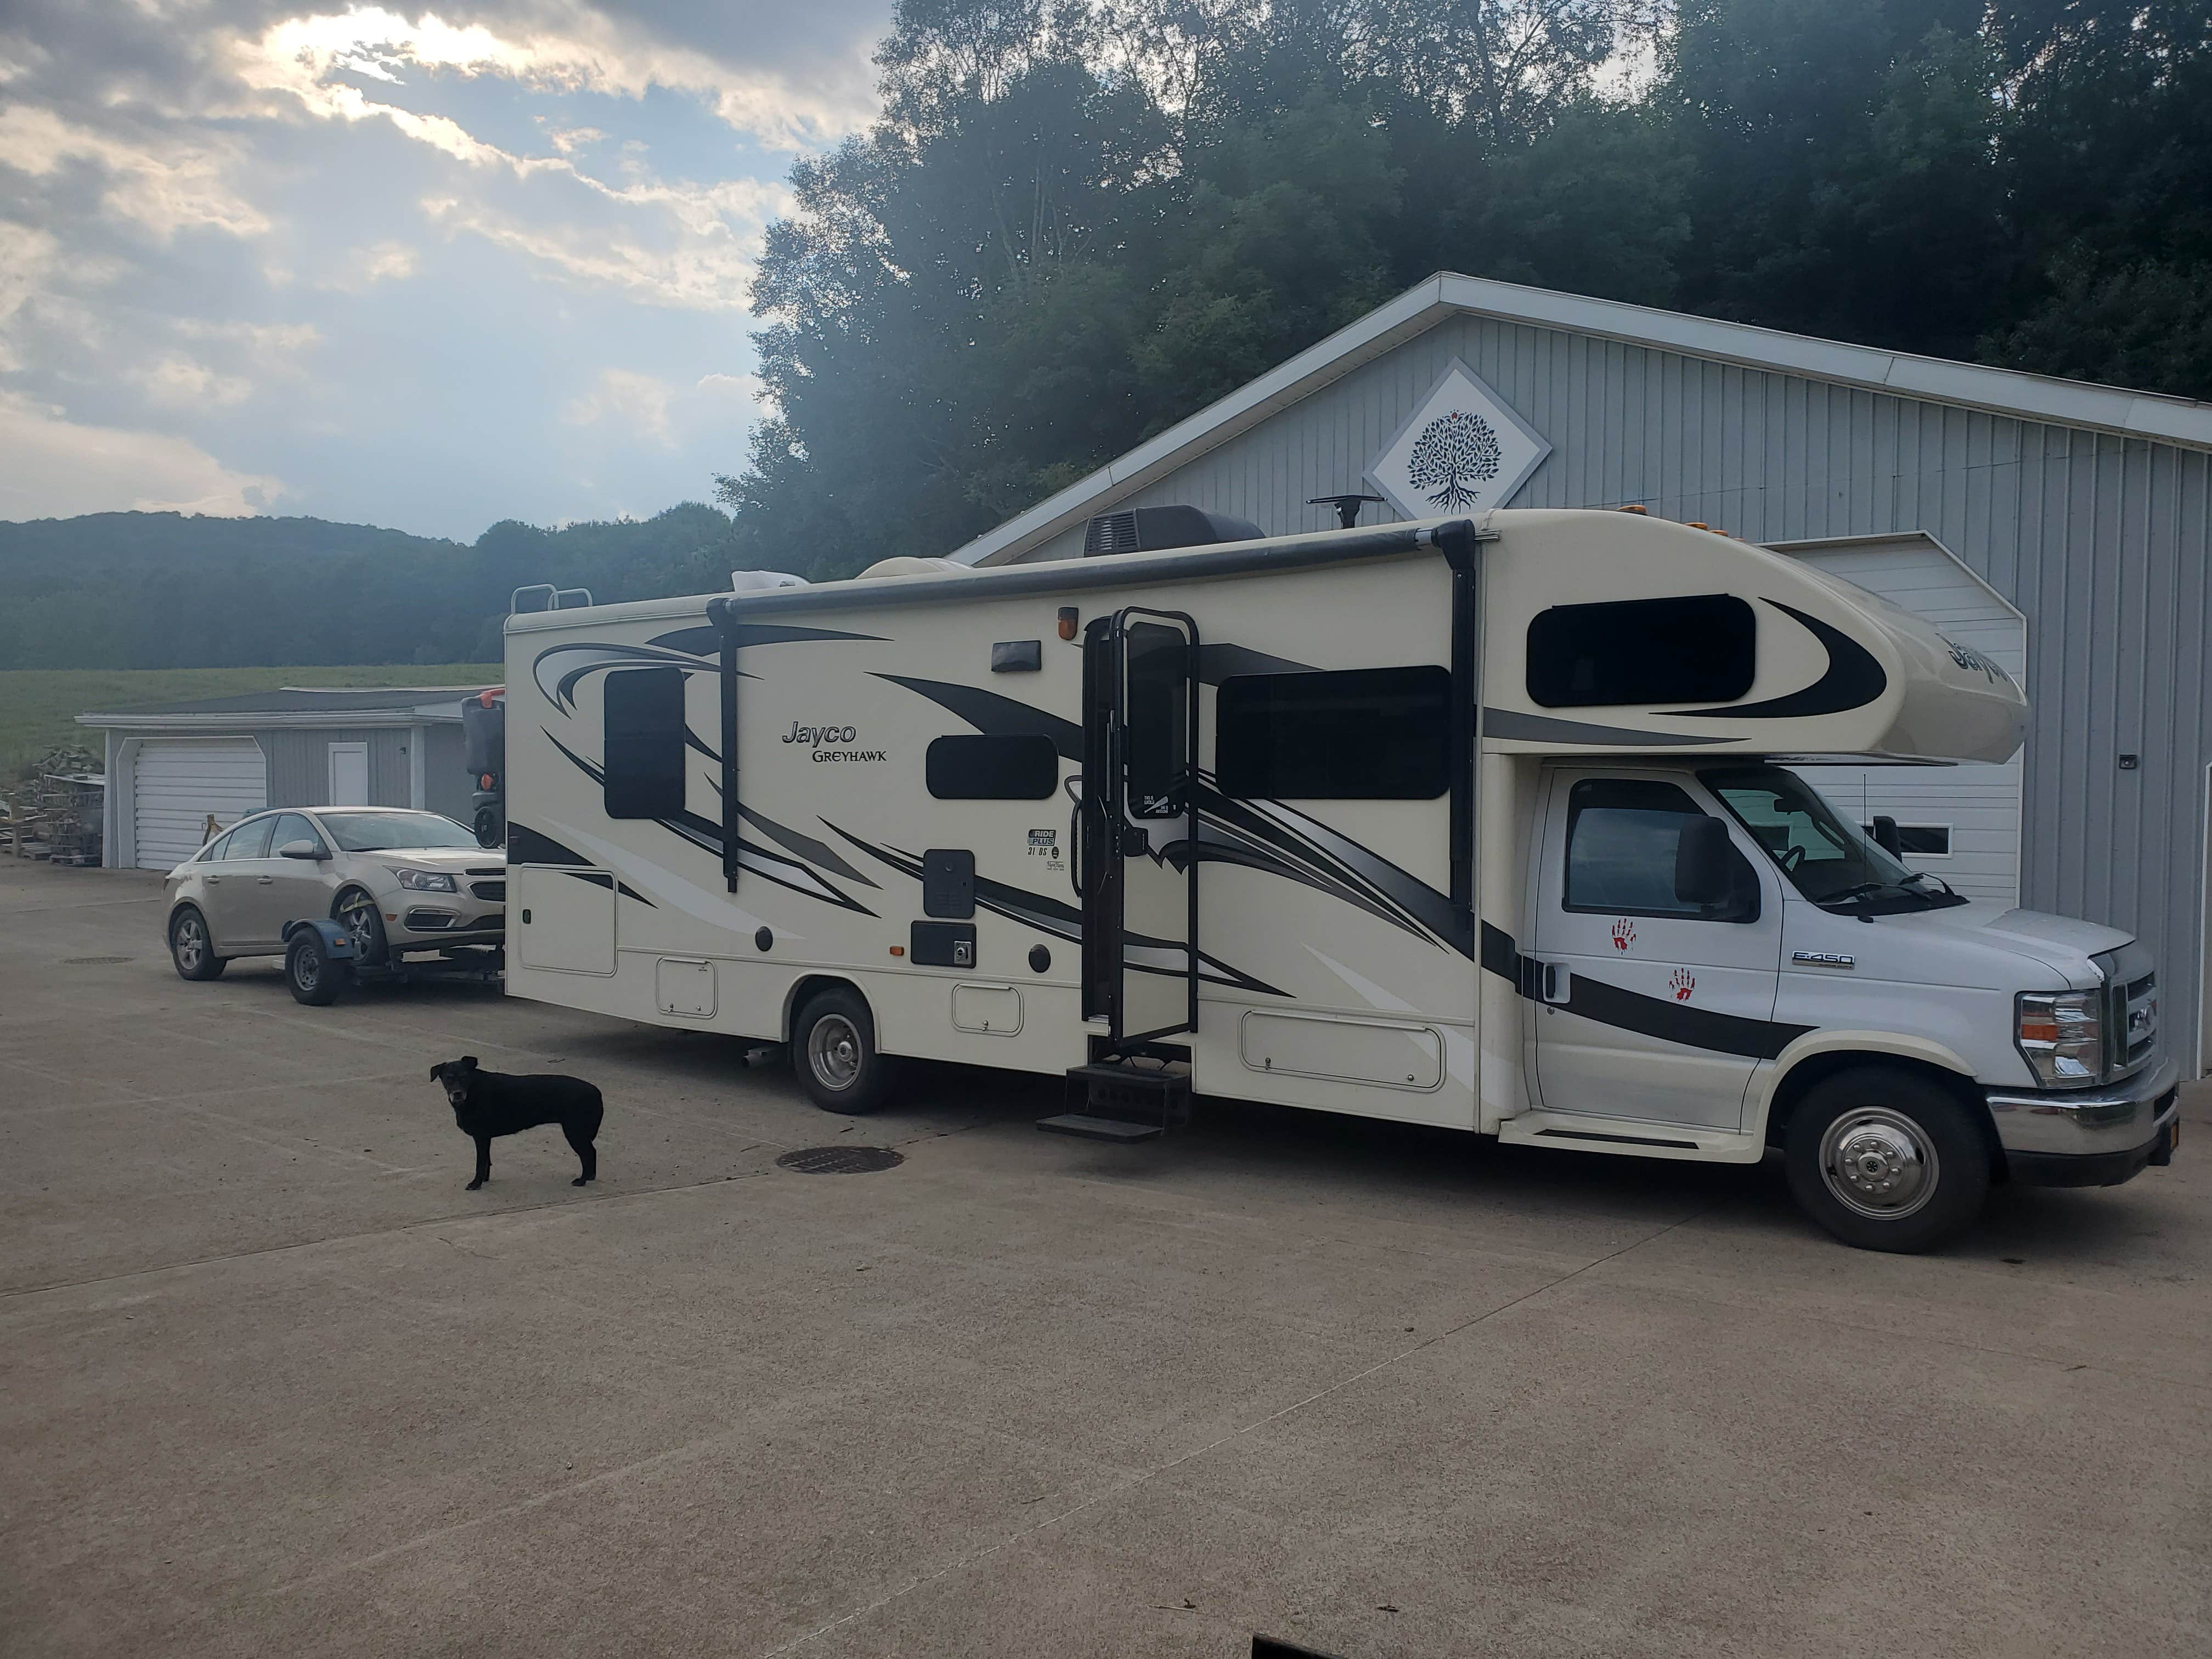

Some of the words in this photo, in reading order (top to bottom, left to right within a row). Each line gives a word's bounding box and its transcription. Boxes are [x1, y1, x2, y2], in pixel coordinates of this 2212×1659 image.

[782, 721, 856, 748] Jayco
[812, 751, 887, 763] GREYHAWK
[1028, 847, 1036, 856] 31
[1039, 847, 1048, 856] DS
[1793, 952, 1854, 964] E-450
